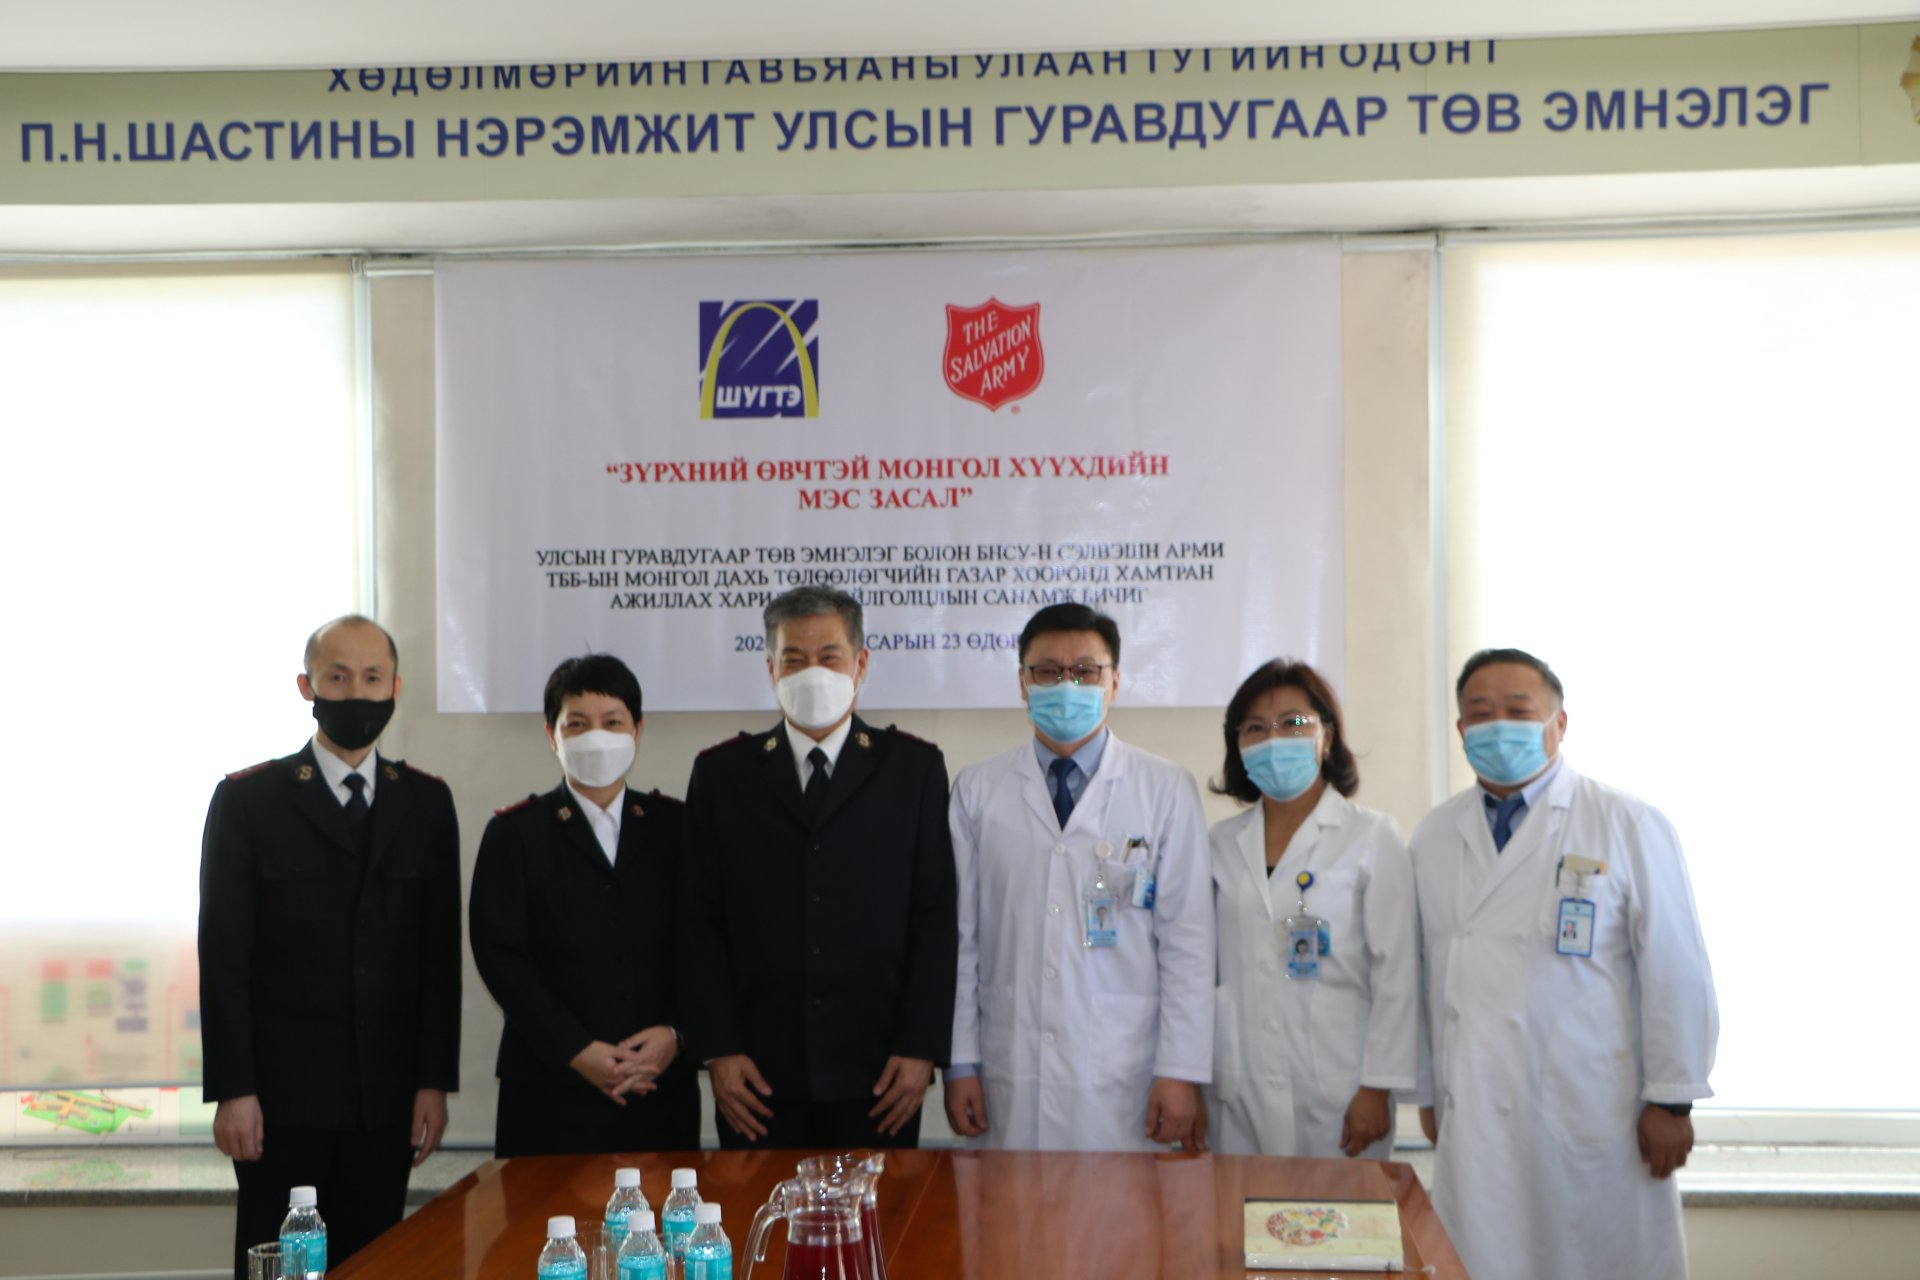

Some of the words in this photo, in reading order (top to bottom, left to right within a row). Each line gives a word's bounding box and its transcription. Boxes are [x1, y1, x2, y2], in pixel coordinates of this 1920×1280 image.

[975, 50, 1127, 79] УЛААН
[20, 118, 415, 162] П.Н.ШАСТИНЫ
[436, 112, 756, 158] НЭРЭМЖИТ
[772, 107, 972, 151] УЛСЫН
[995, 96, 1387, 150] ГУРАВДУГААР
[1407, 93, 1521, 134] ТӨВ
[1544, 83, 1830, 132] ЭМНЭЛЭГ
[963, 309, 999, 346] THE
[950, 313, 1032, 385] SALVATION
[980, 345, 1030, 397] ARMY
[716, 385, 801, 408] ШУГТЭ
[755, 455, 869, 481] ӨВЧТЭЙ
[878, 457, 1000, 480] МОНГОЛ
[1009, 451, 1169, 480] ХҮҮХДИЙН
[799, 488, 861, 510] МЭС
[536, 549, 606, 567] УЛСЫН
[611, 547, 751, 567] ГУРАВДУГААР
[755, 547, 796, 564] ТӨВ
[800, 545, 898, 564] ЭМНЭЛЭГ
[903, 544, 971, 562] БОЛОН
[976, 543, 1052, 562] БНСУ-Н
[1165, 541, 1224, 559] АРМИ
[546, 571, 619, 588] ТББ-ЫН
[624, 570, 709, 587] МОНГОЛ
[713, 569, 770, 589] ДАХЬ
[774, 565, 942, 585] ТӨЛӨӨЛӨГЧИЙН
[946, 566, 1007, 584] ГАЗАР
[1012, 565, 1110, 585] ХООРОНД
[1115, 564, 1214, 582] ХАМТРАН
[610, 591, 712, 609] АЖИЛЛАХ
[982, 587, 1076, 605] САНАМЖ
[866, 634, 935, 651] САРЫН
[941, 632, 962, 651] 23
